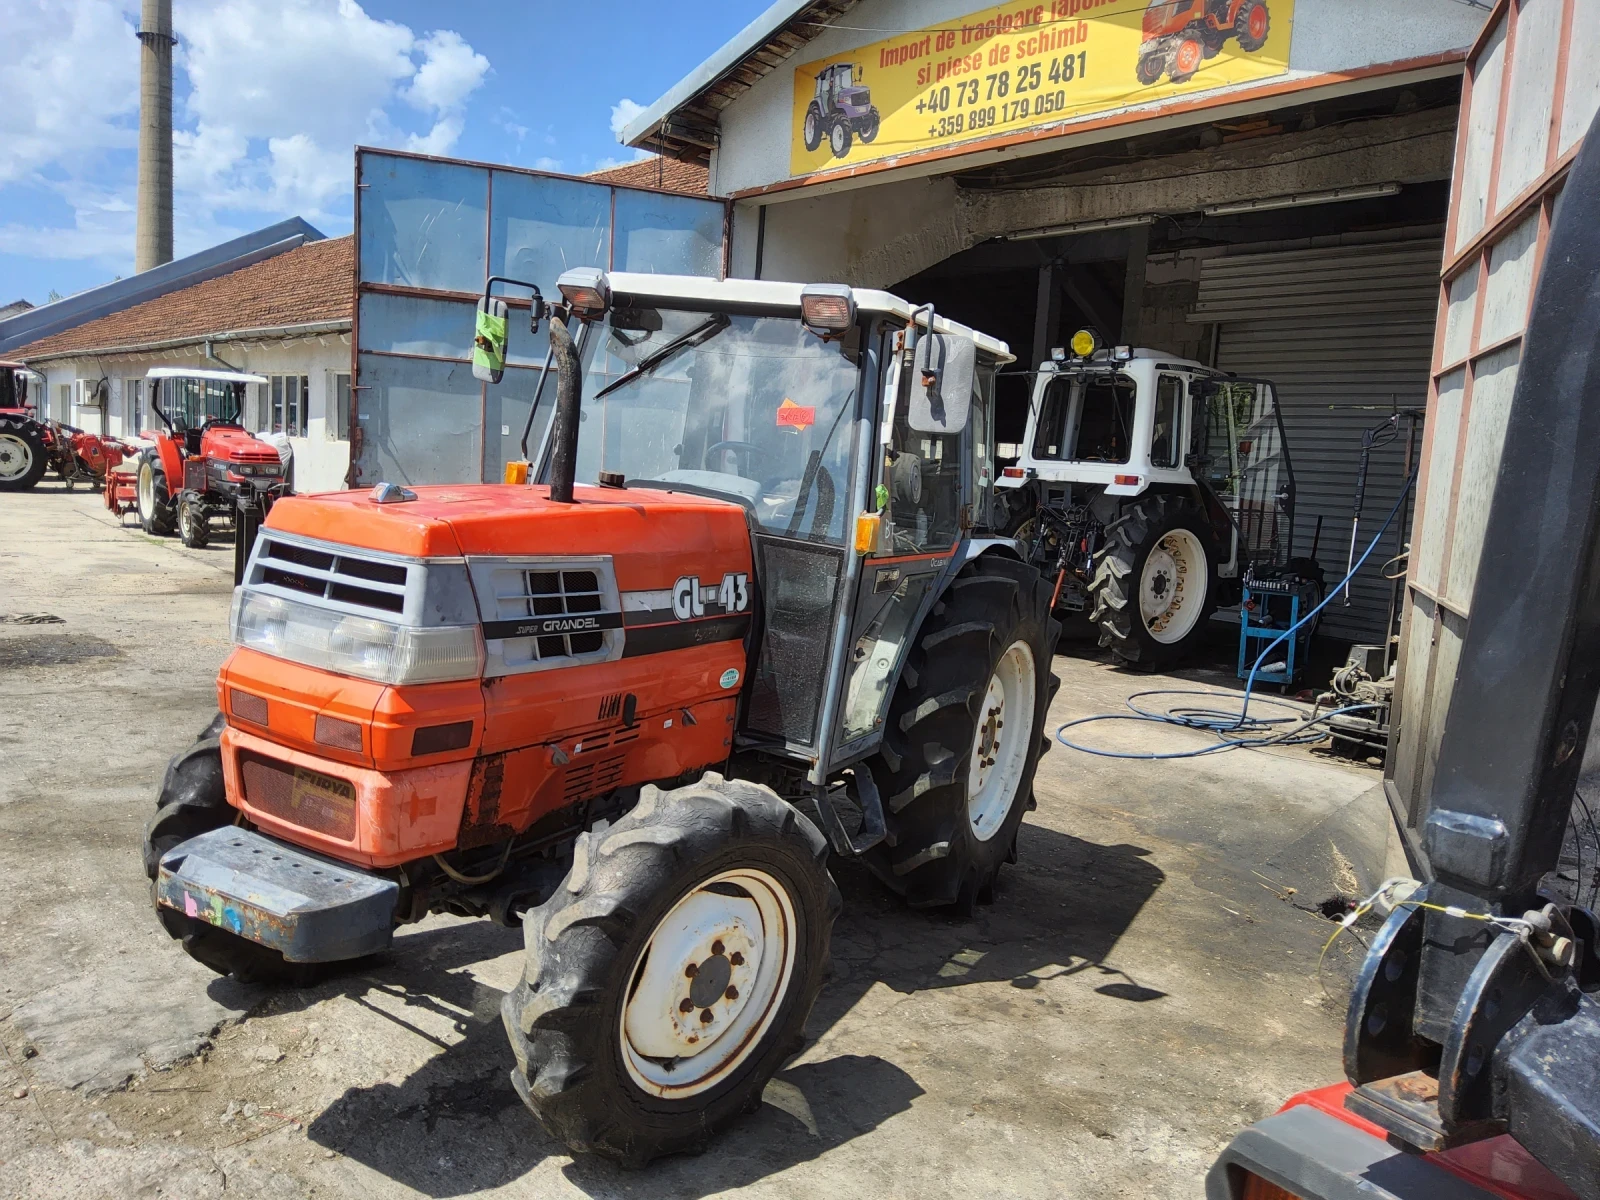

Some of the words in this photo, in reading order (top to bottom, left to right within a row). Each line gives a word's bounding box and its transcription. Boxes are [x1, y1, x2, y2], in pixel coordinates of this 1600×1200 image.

[880, 34, 931, 69] Import
[936, 28, 956, 52] de
[961, 4, 1044, 45] tractoare
[917, 62, 932, 86] si
[936, 52, 983, 84] piese
[989, 43, 1011, 67] de
[1016, 20, 1089, 60] schimb
[915, 85, 951, 115] +40
[956, 78, 980, 108] 73
[985, 70, 1010, 101] 78
[1015, 62, 1042, 94] 25
[1048, 50, 1087, 85] 481
[928, 113, 964, 138] +359
[968, 105, 996, 131] 899
[1001, 98, 1030, 124] 179
[1034, 90, 1066, 116] 050
[672, 572, 749, 622] GL-43
[515, 625, 539, 635] SUPER
[542, 617, 600, 632] GRANDEL
